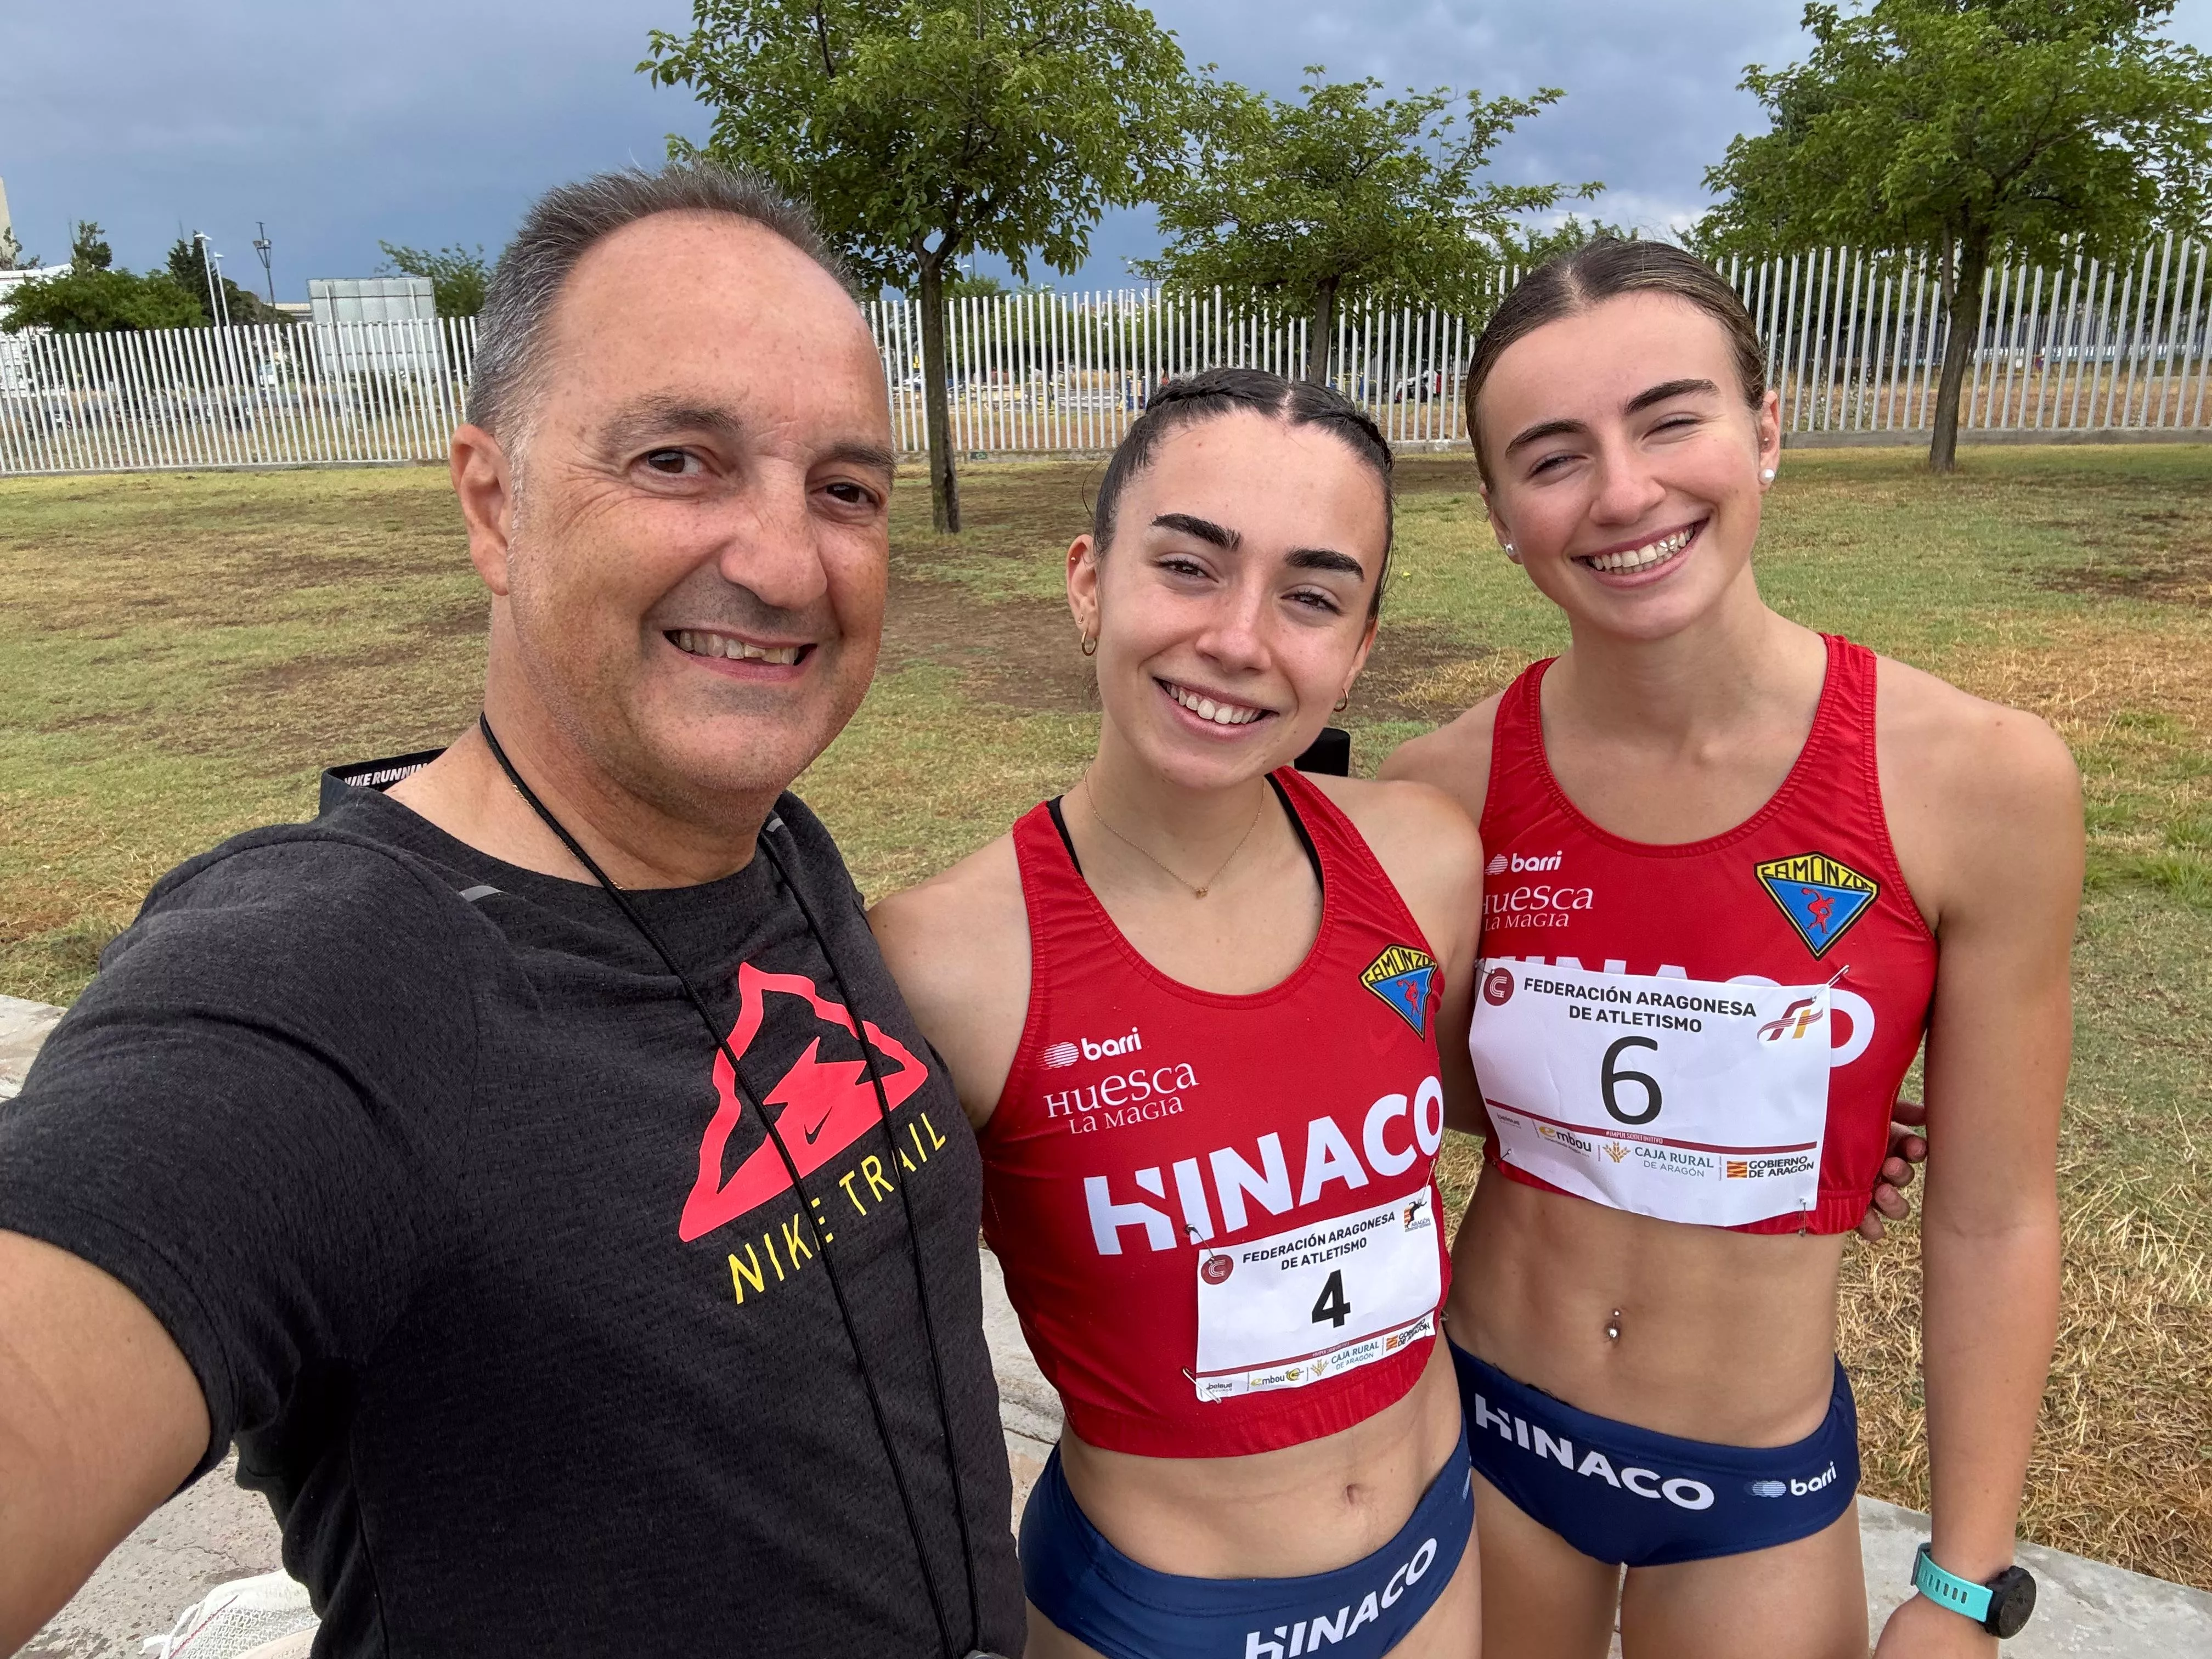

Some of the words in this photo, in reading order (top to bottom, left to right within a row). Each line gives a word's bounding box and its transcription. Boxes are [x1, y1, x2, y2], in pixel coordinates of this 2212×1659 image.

[345, 773, 372, 786] NIKE
[1511, 850, 1562, 872] barri
[1523, 978, 1632, 1004] FEDERACIÓN
[1636, 991, 1757, 1017] ARAGONESA
[1569, 1005, 1592, 1020] DE
[1596, 1009, 1702, 1032] ATLETISMO
[1080, 1026, 1142, 1060] barri
[1600, 1036, 1662, 1125] 6
[1083, 1076, 1443, 1255] HINACO
[1634, 1147, 1667, 1161] CAJA
[1669, 1152, 1714, 1168] RURAL
[1644, 1160, 1657, 1169] DE
[1660, 1164, 1704, 1177] ARAGÓN
[1748, 1156, 1808, 1170] GOBIERNO
[1748, 1169, 1764, 1178] DE
[728, 1198, 834, 1305] NIKE
[839, 1112, 946, 1216] TRAIL
[1243, 1233, 1325, 1263] FEDERACIÓN
[1328, 1211, 1395, 1243] ARAGONESA
[1281, 1256, 1298, 1271] DE
[1301, 1237, 1367, 1266] ATLETISMO
[1311, 1268, 1351, 1328] 4
[1331, 1351, 1350, 1364] CAJA
[1352, 1341, 1379, 1356] RURAL
[1346, 1352, 1374, 1366] ARAGÓN
[1475, 1393, 1715, 1510] HINACO
[1790, 1461, 1837, 1497] barri
[1245, 1538, 1437, 1659] HINACO
